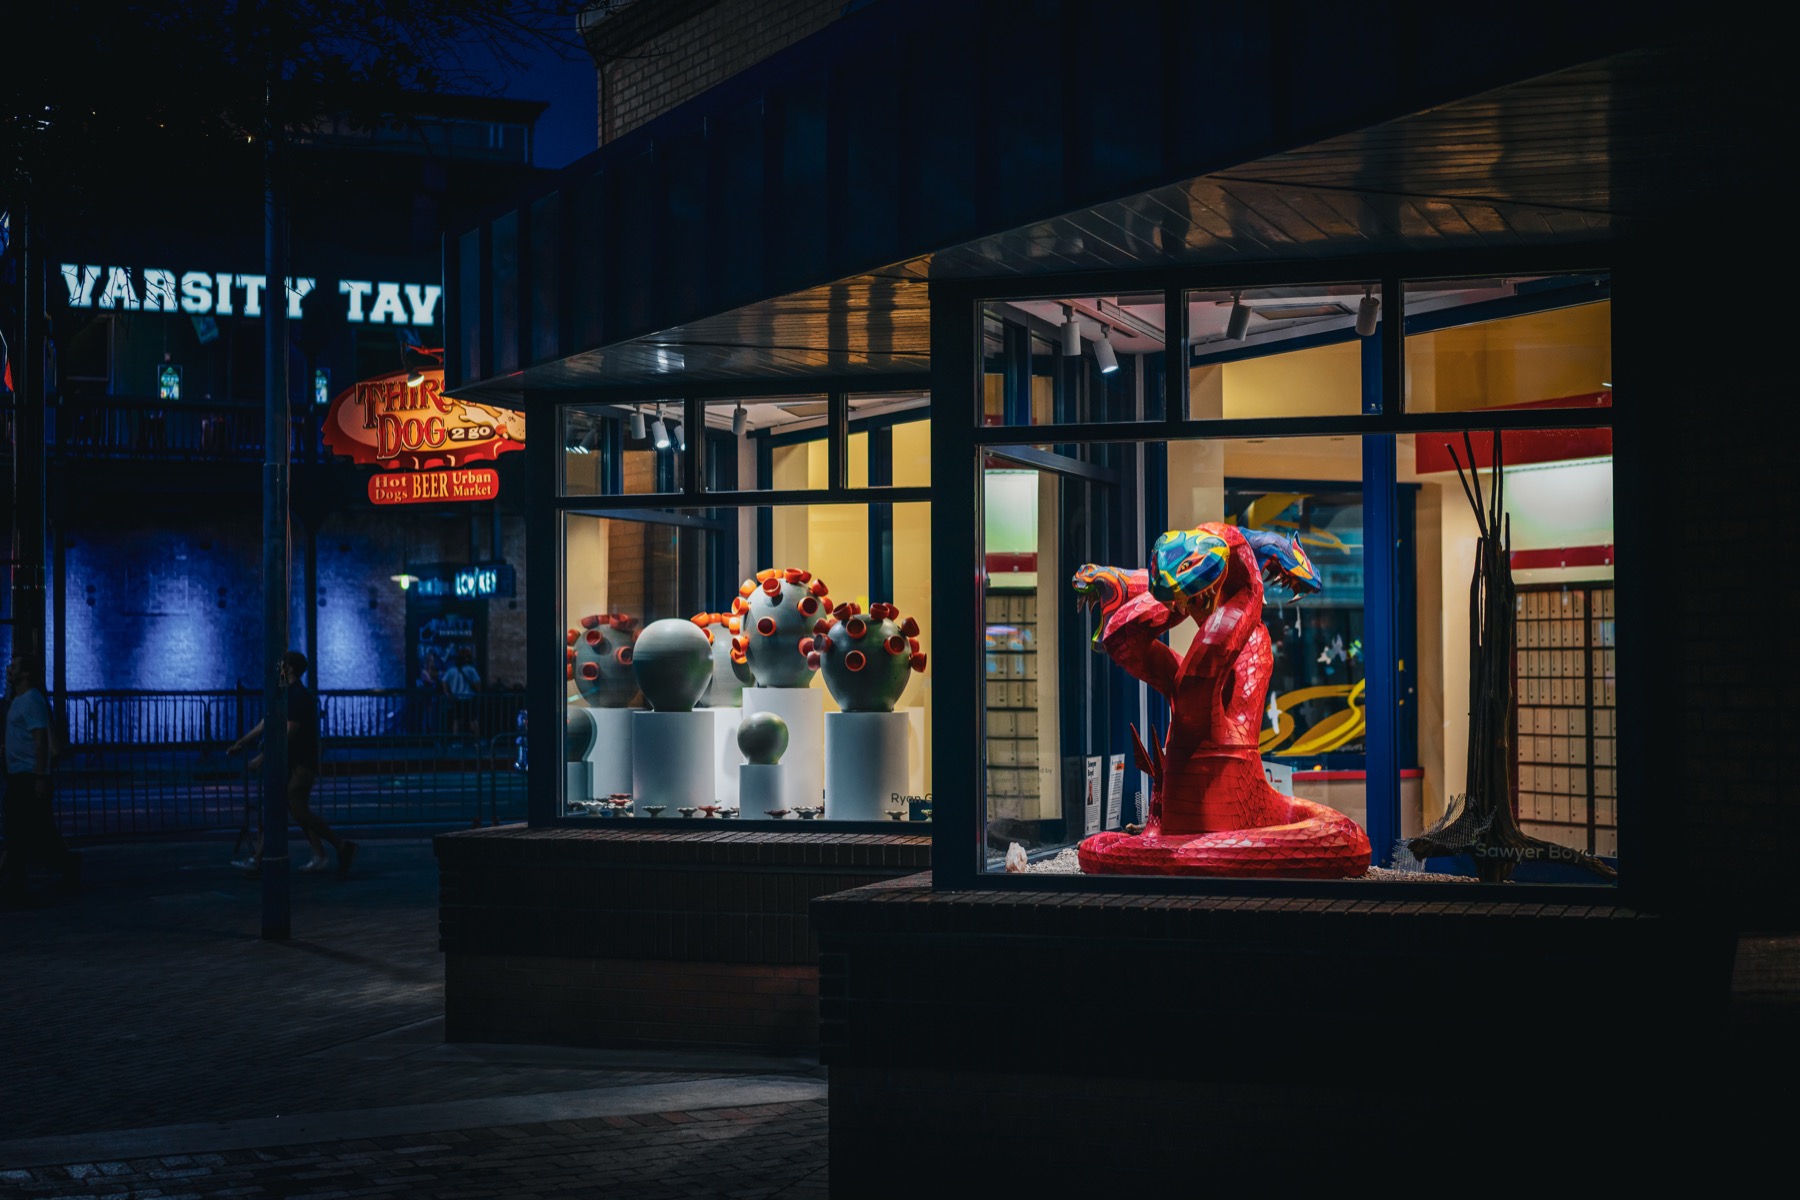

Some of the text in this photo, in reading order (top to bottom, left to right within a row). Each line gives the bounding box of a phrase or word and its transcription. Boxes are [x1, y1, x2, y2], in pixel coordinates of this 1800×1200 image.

[60, 263, 442, 325] VARSITY TAV
[376, 413, 490, 460] DOG 2 go
[375, 477, 407, 488] Hot
[452, 471, 491, 485] Urban
[412, 472, 449, 499] BEER
[453, 484, 491, 497] Market
[375, 489, 408, 502] Dogs
[891, 792, 921, 805] Ryan
[1475, 843, 1544, 863] Sawyer
